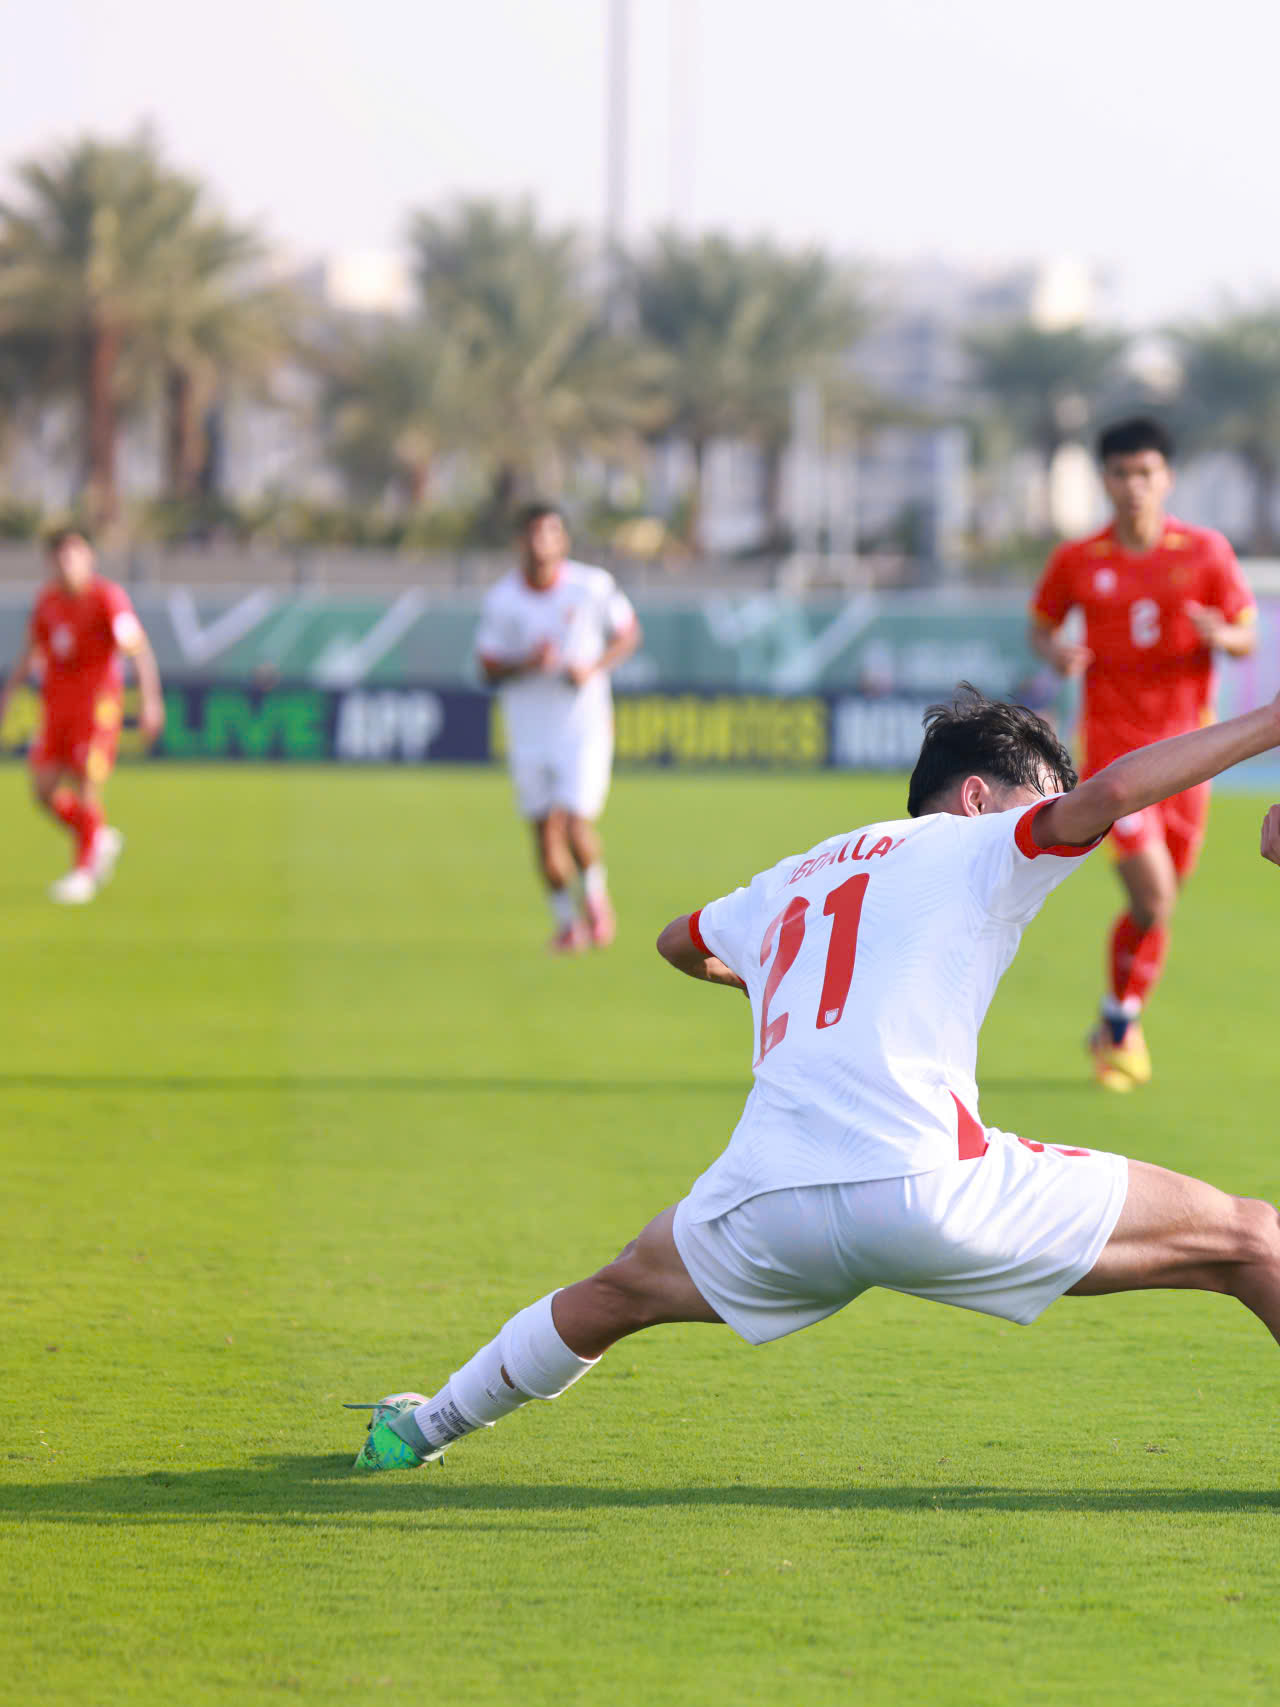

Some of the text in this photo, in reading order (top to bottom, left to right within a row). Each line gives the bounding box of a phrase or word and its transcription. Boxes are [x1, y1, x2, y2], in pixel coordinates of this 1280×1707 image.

[163, 691, 325, 758] LIVE
[335, 690, 443, 758] APP
[752, 872, 870, 1071] 21
